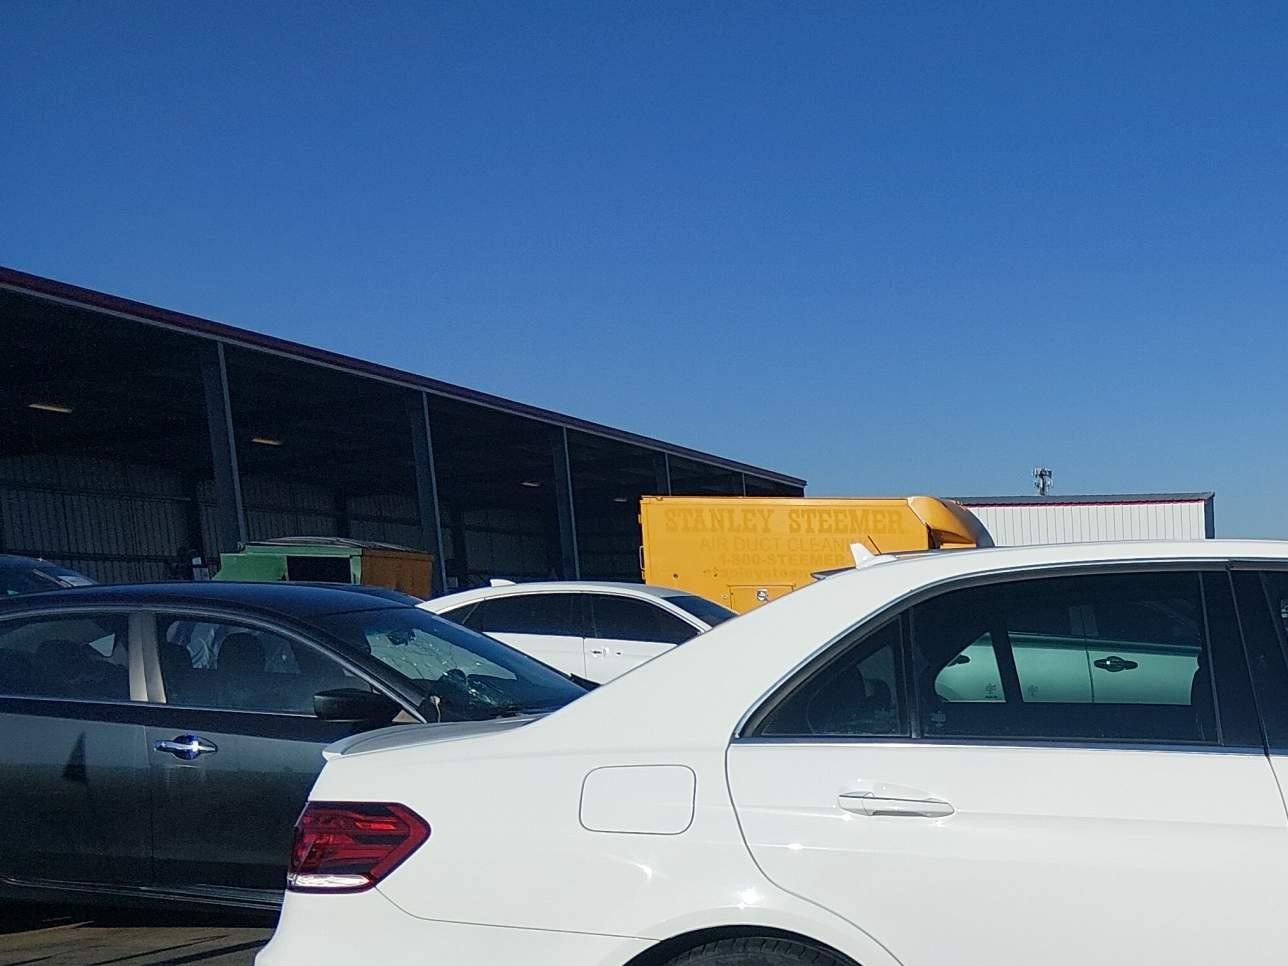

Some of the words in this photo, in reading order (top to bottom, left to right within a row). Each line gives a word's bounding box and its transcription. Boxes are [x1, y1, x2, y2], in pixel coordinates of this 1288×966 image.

[664, 508, 775, 533] STANLEY
[788, 509, 906, 534] STEEMER
[698, 536, 729, 552] AIR
[733, 536, 782, 552] DUCT
